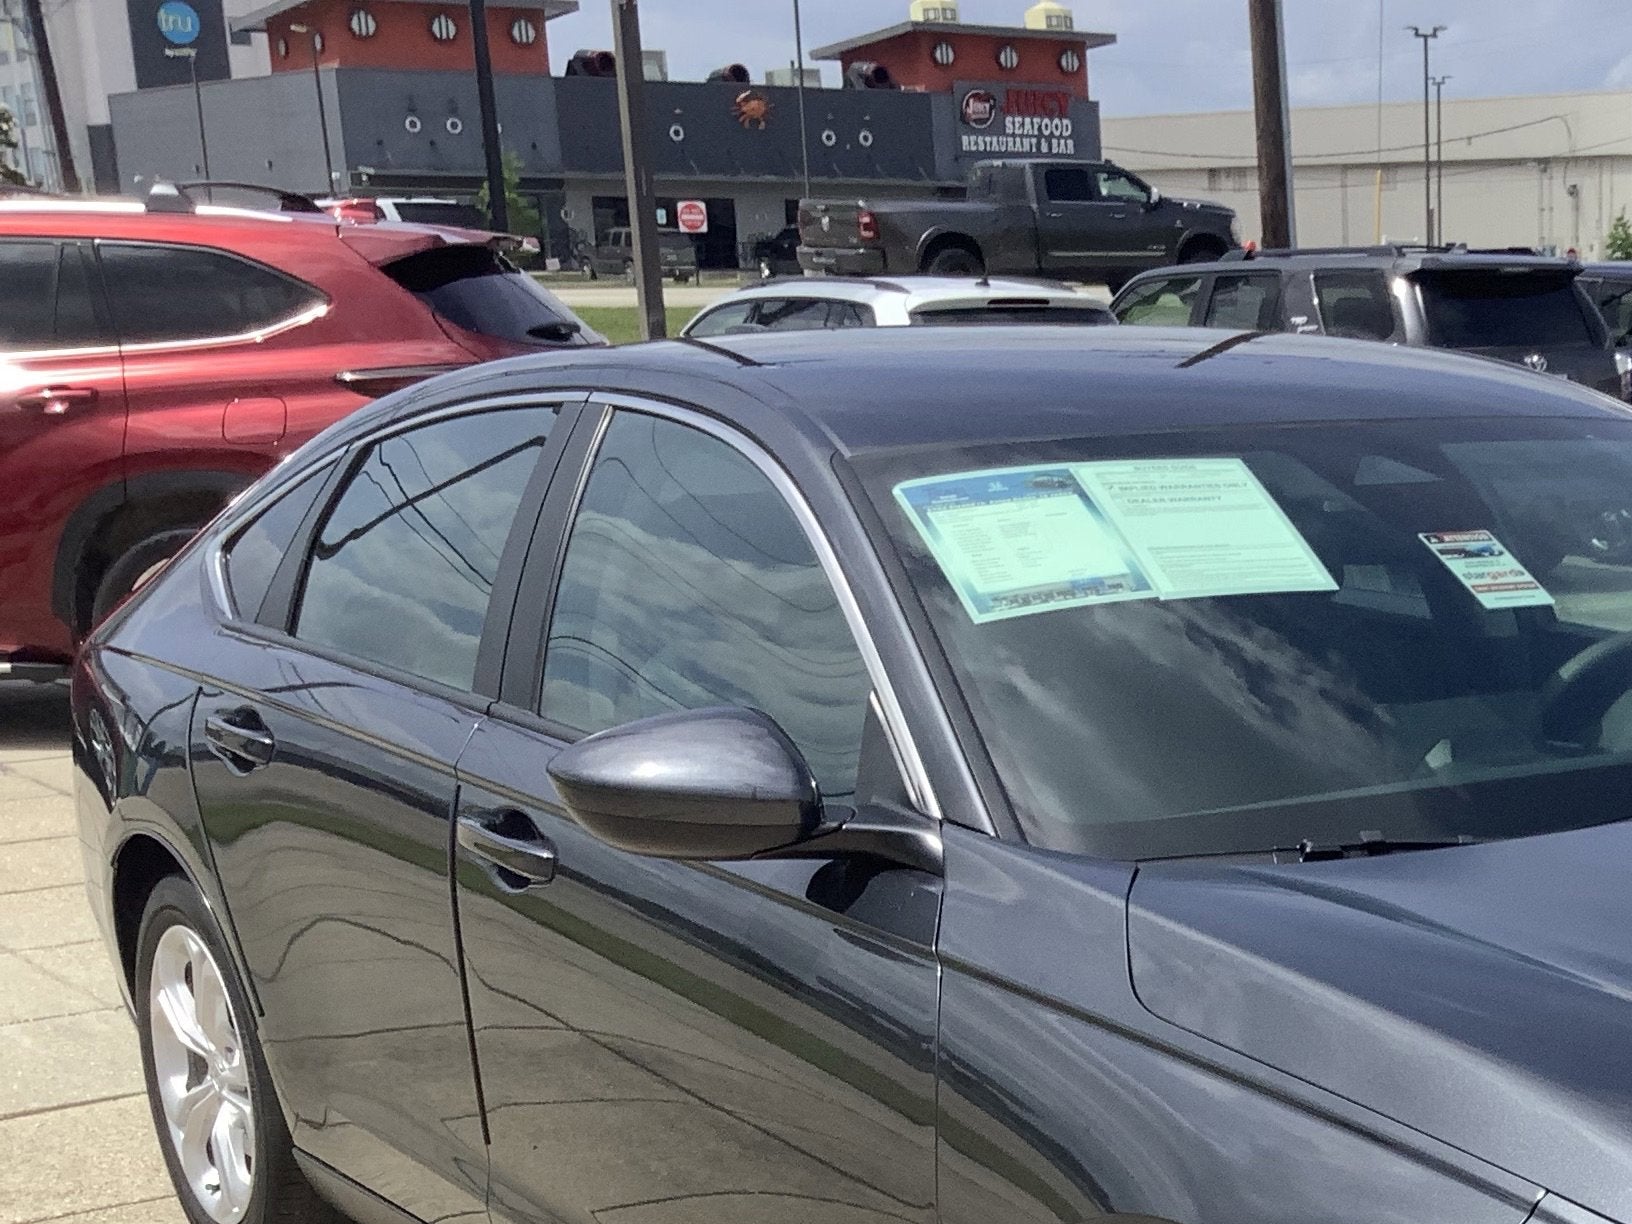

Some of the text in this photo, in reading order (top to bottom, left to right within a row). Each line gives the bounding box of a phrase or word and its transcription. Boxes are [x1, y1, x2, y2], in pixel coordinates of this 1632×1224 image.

[157, 8, 193, 33] tru
[1003, 89, 1069, 117] JUICY
[1005, 116, 1072, 136] SEAFOOD
[961, 135, 1074, 154] RESTAURANT & BAR
